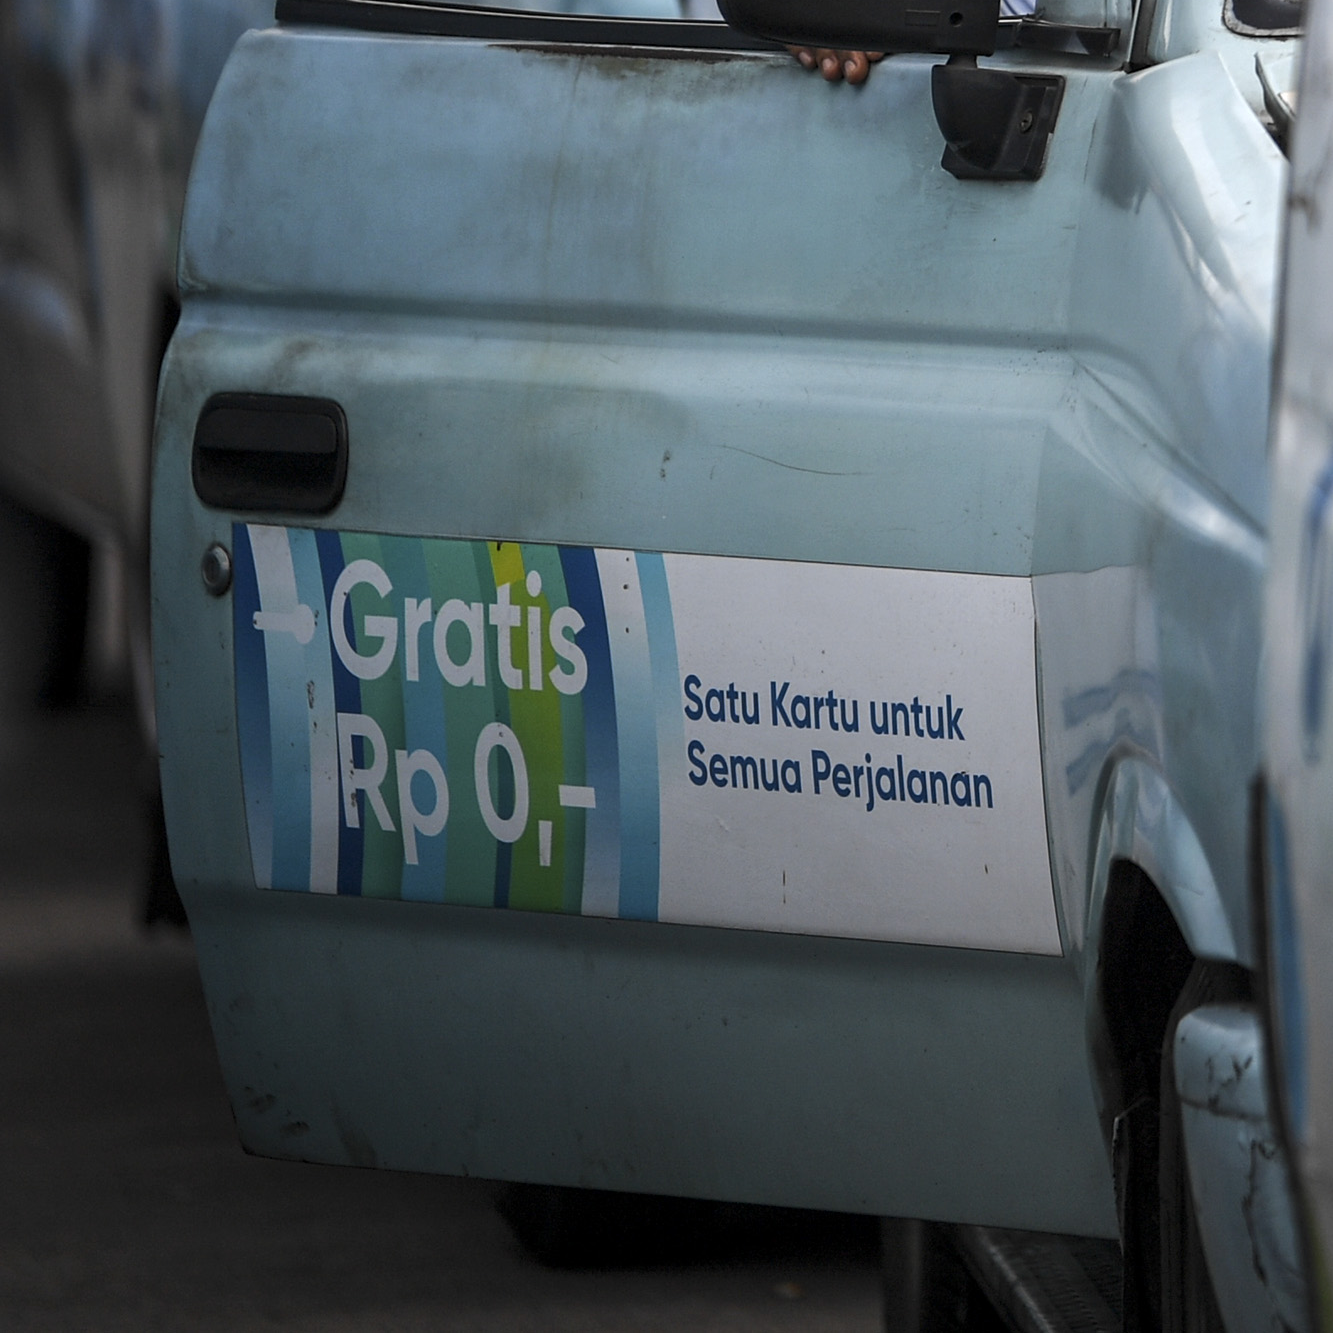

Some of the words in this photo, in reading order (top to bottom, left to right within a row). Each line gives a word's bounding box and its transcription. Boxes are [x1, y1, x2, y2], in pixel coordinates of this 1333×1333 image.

[331, 559, 588, 695] Gratis
[684, 674, 760, 726] Satu
[770, 681, 859, 733] Kartu
[869, 694, 965, 741] untuk
[336, 712, 450, 866] Rp
[687, 740, 803, 794] Semua
[811, 750, 994, 813] Perjalanan
